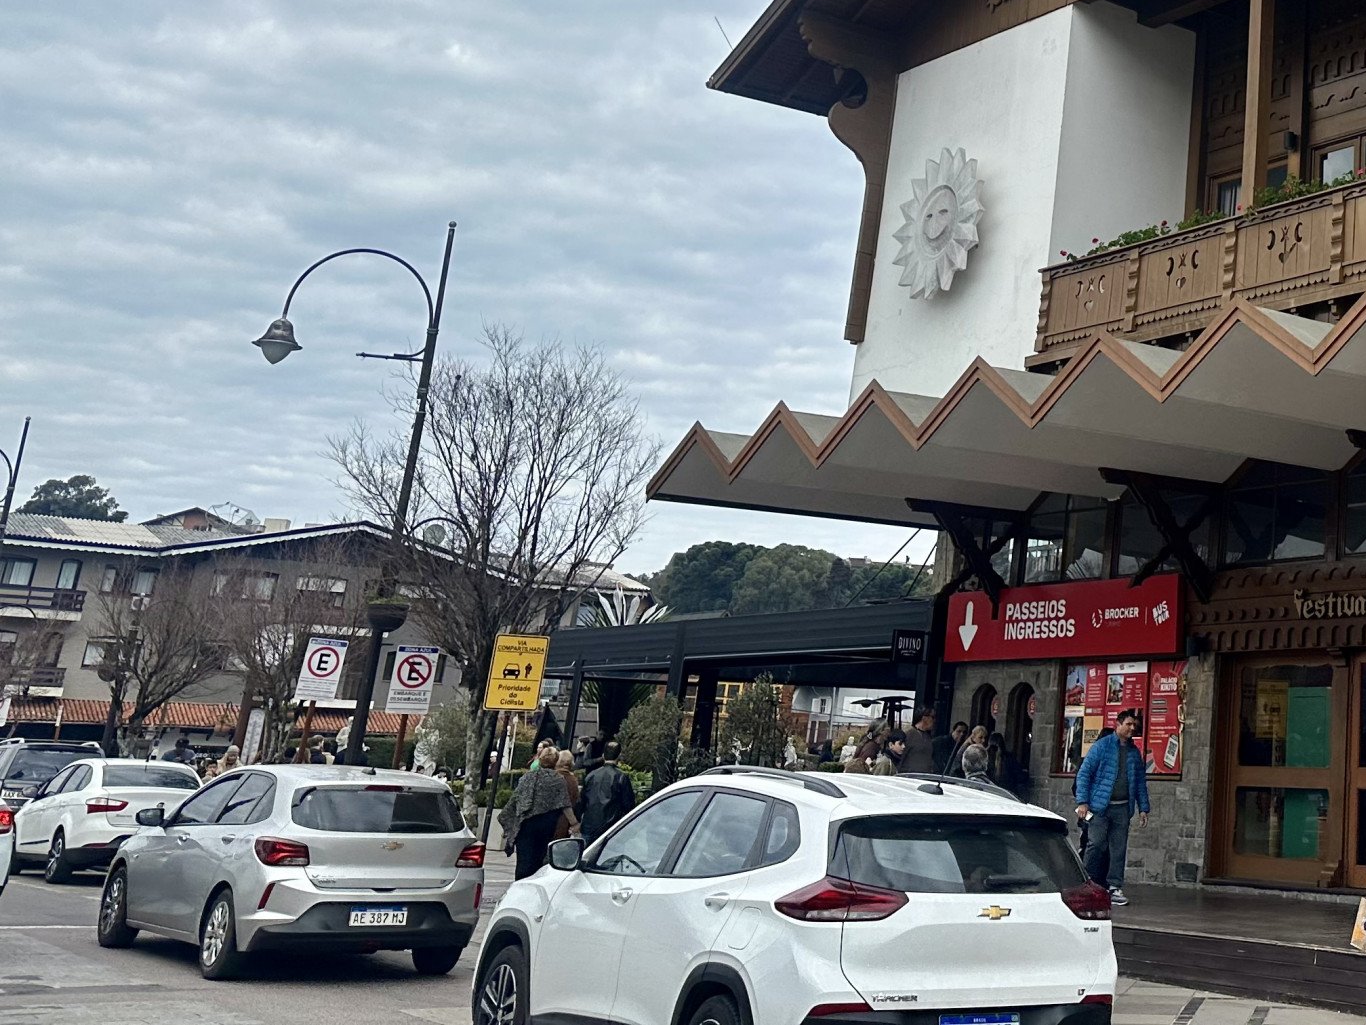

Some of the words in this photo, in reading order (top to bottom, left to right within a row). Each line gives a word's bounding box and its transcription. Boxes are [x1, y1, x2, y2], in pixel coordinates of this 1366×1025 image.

[1005, 599, 1067, 621] PASSEIOS
[1104, 606, 1139, 619] BROCKER
[1152, 600, 1168, 618] BUS
[1154, 610, 1170, 626] TOUR
[1004, 619, 1075, 641] INGRESSOS
[898, 636, 922, 651] DIVINO
[316, 653, 331, 671] E
[353, 913, 366, 924] AE
[369, 913, 389, 924] 387
[392, 913, 405, 924] MJ
[871, 993, 918, 1003] TRACKER
